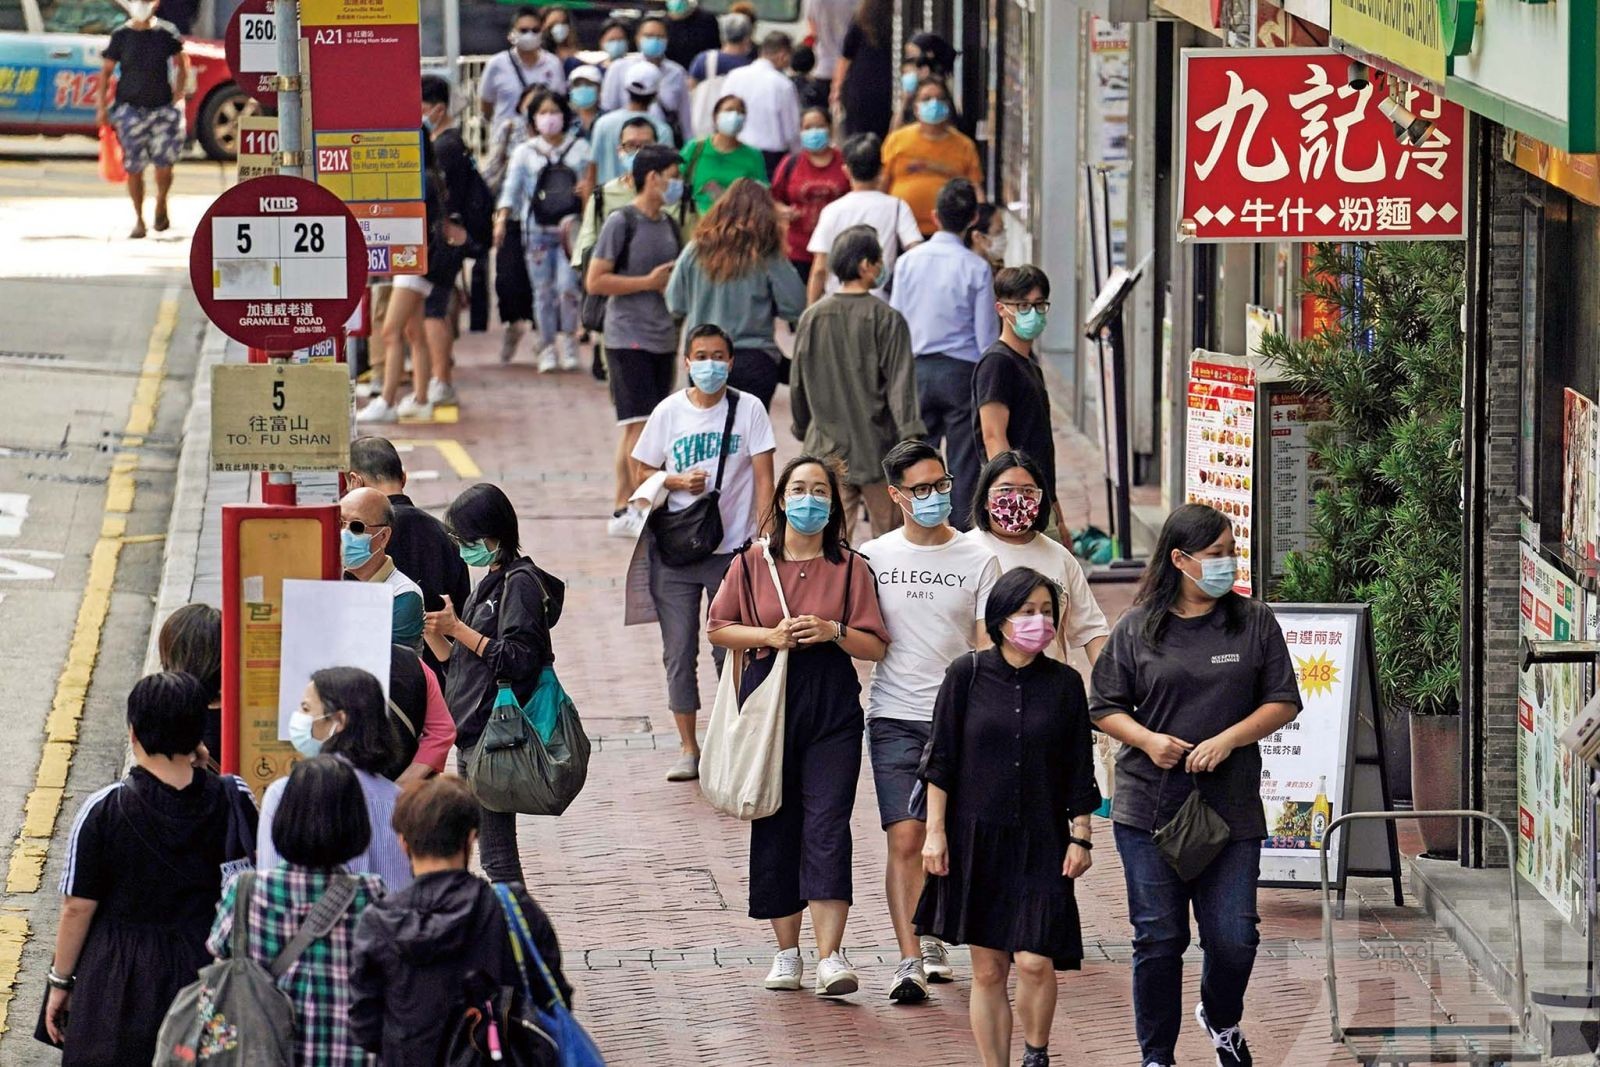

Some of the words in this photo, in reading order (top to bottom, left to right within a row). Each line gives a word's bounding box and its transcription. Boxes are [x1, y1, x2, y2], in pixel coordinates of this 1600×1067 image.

[314, 29, 342, 45] A21
[1194, 63, 1387, 184] 九記
[246, 131, 279, 153] 110
[319, 150, 349, 171] E21X
[366, 148, 400, 160] 紅磡站
[362, 161, 379, 171] Hung
[380, 161, 395, 169] Hom
[397, 161, 418, 169] Station
[1240, 197, 1312, 232] 牛什
[1338, 196, 1412, 231] 粉麵
[237, 223, 252, 254] 5
[294, 222, 325, 253] 28
[374, 232, 391, 241] Tsui
[247, 302, 314, 317] 加連威老道
[239, 317, 290, 326] GRANVILLE
[296, 317, 323, 325] ROAD
[273, 381, 285, 411] 5
[249, 415, 308, 432] 往富山
[227, 434, 252, 445] TO:
[261, 434, 280, 445] FU
[289, 434, 331, 445] SHAN
[878, 567, 967, 587] CÉLEGACY
[906, 590, 934, 600] PARIS
[1286, 630, 1343, 645] 自選兩款
[1300, 664, 1331, 681] $48
[1262, 769, 1271, 780] 魚
